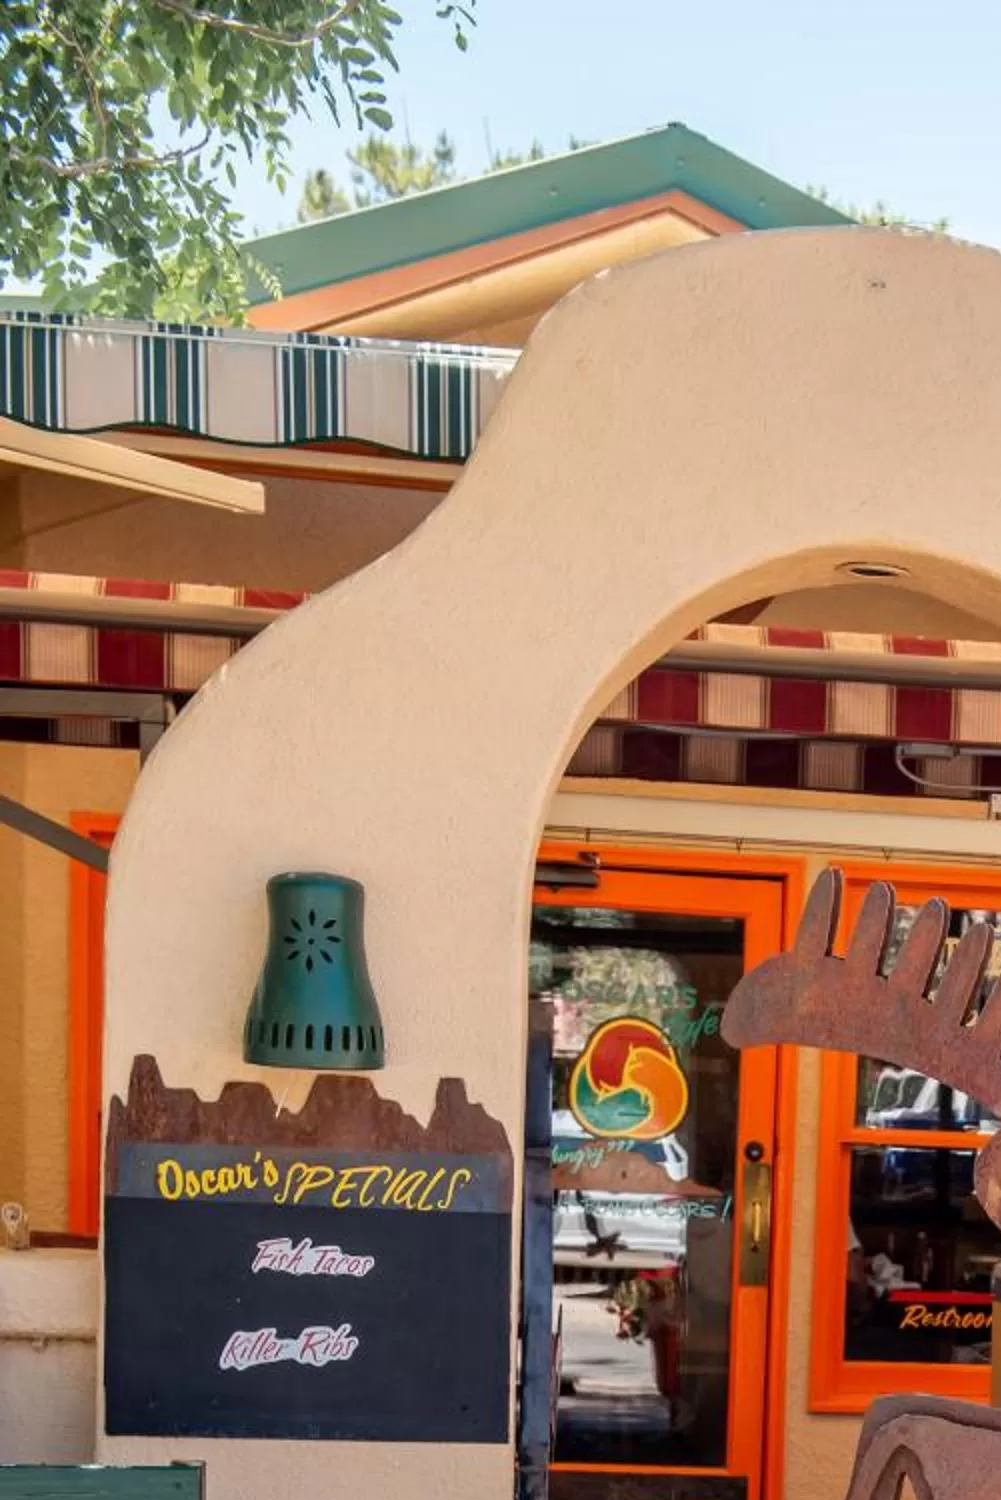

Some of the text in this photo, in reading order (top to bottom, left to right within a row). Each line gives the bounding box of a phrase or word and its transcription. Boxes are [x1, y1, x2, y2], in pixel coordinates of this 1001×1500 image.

[157, 1151, 471, 1211] Oscar's SPECIALS
[252, 1238, 375, 1277] Fish Tacos
[220, 1324, 359, 1371] Killer Ribs
